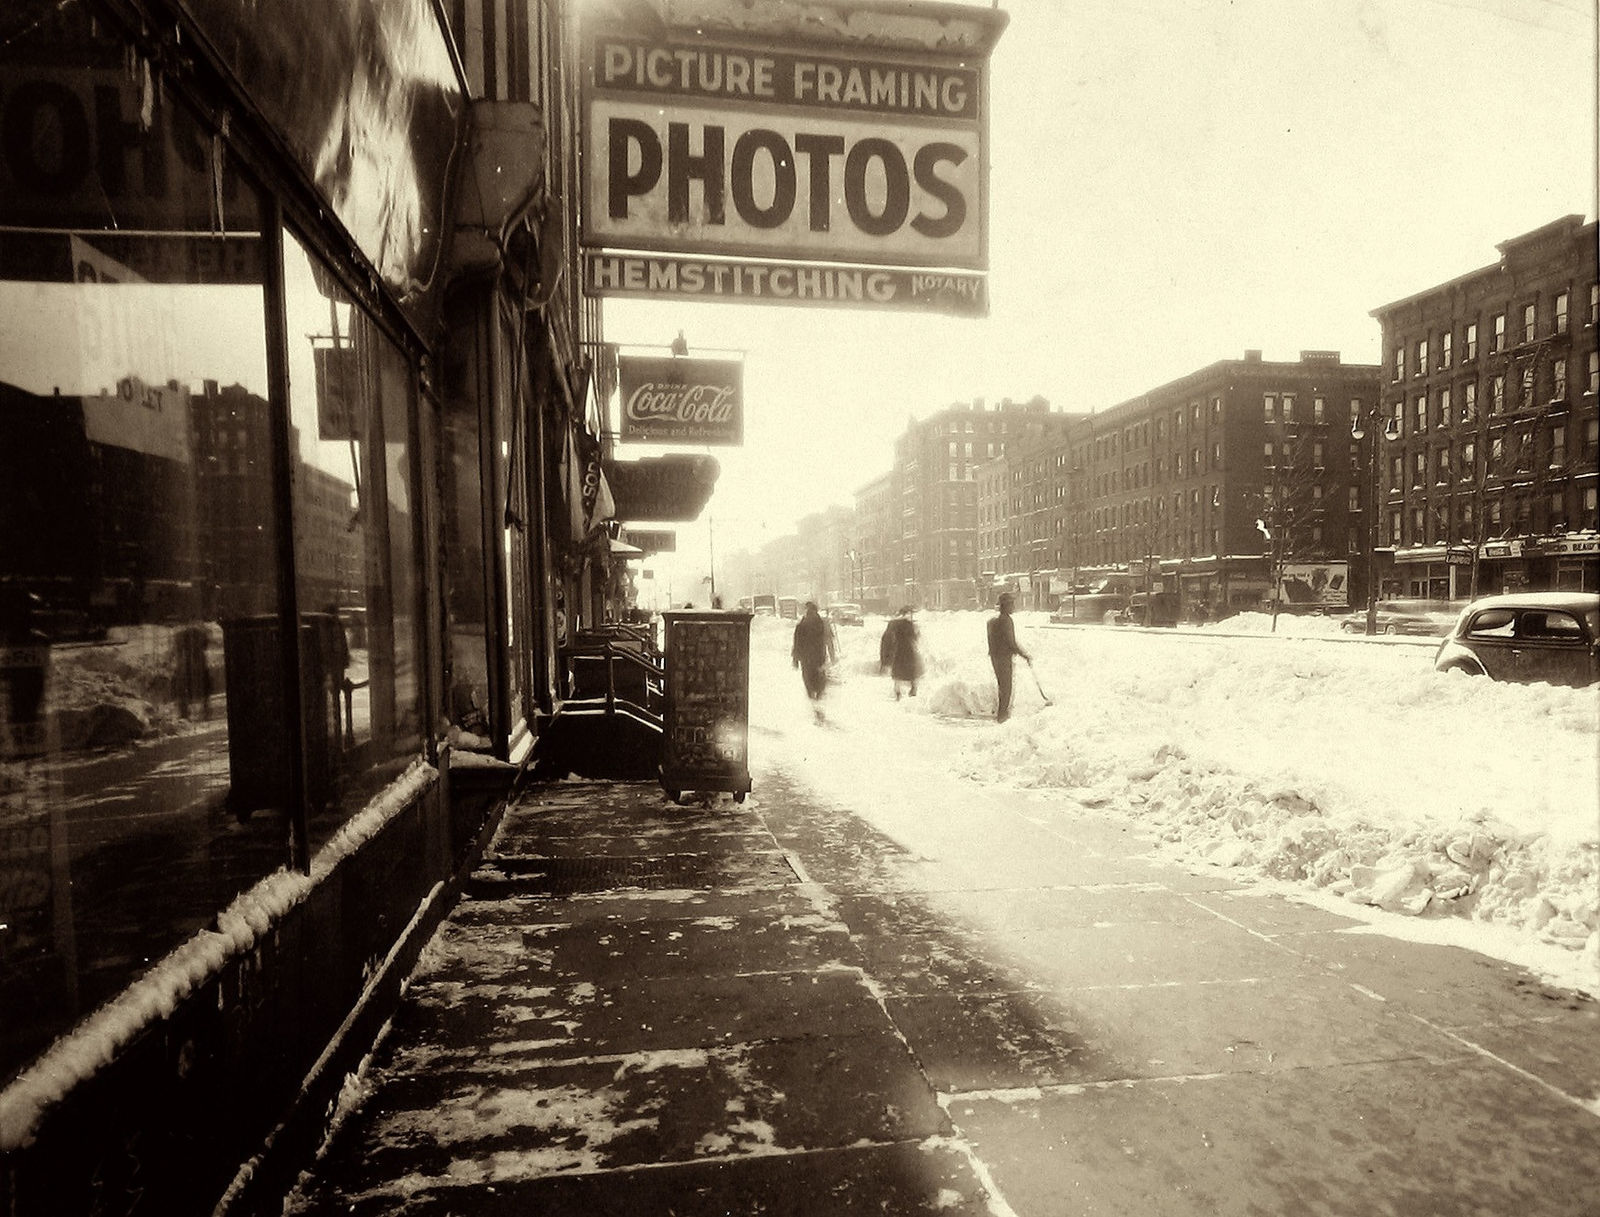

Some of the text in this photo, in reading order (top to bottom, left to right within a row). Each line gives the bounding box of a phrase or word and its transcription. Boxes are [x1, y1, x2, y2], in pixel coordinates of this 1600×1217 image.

[604, 45, 968, 113] PICTURE FRAMING
[608, 117, 969, 239] PHOTOS
[593, 258, 897, 301] HEMSTITCHING
[911, 273, 980, 299] NOTARY
